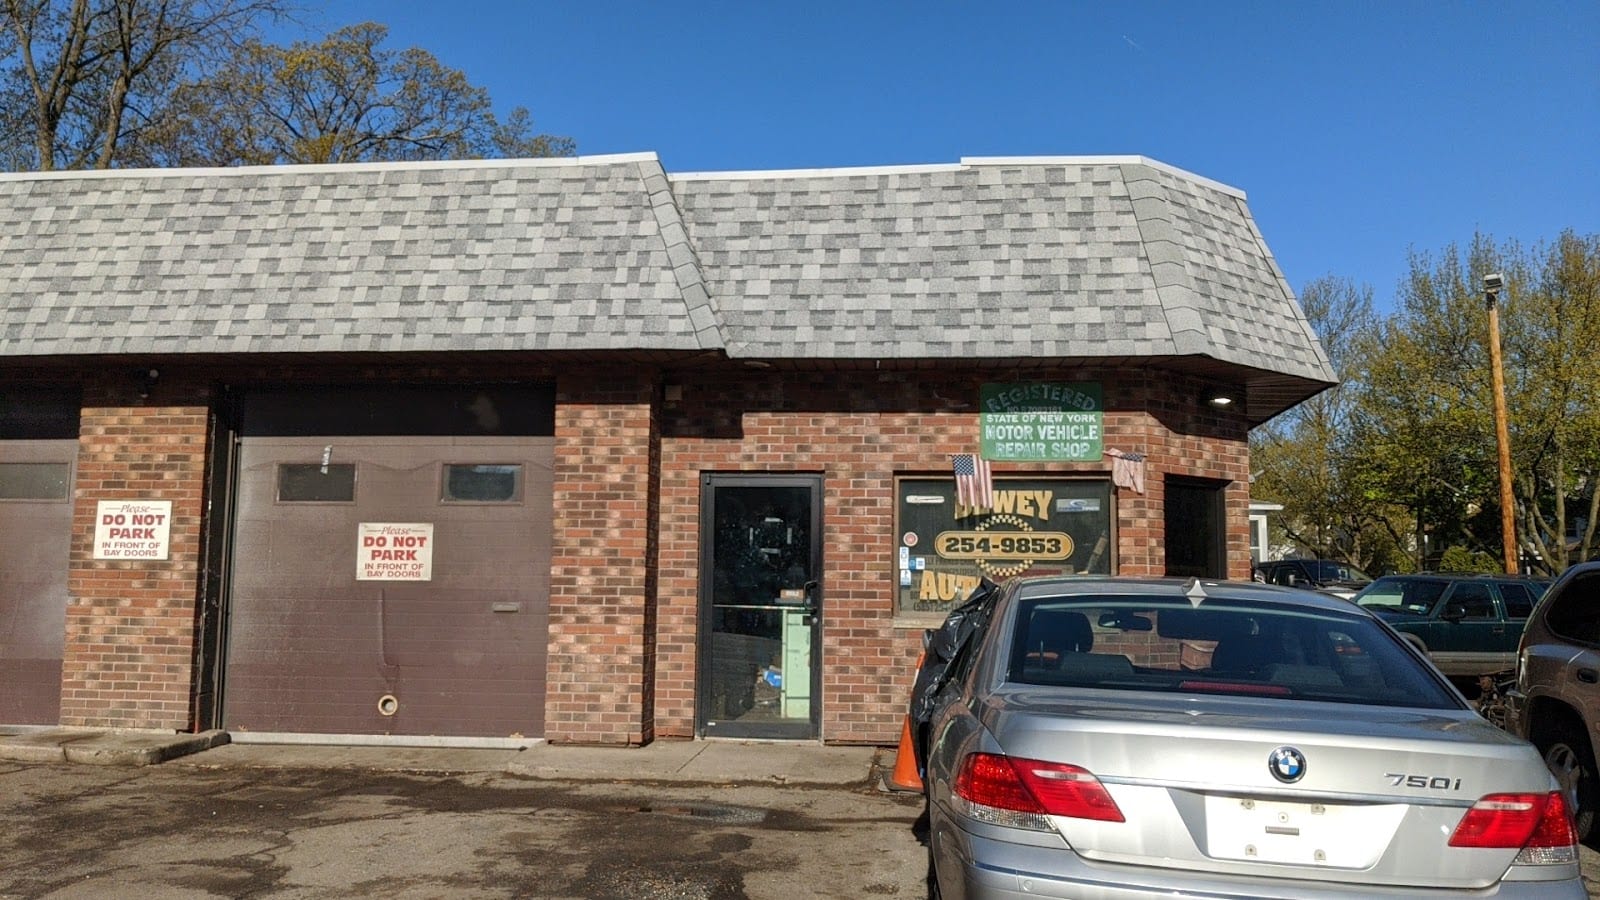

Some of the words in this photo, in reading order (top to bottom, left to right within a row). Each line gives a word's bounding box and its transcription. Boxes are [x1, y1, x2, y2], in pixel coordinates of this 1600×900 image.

[986, 384, 1096, 412] REGISTERED
[986, 414, 1019, 423] STATE
[1022, 414, 1037, 423] OF
[1040, 414, 1064, 423] NEW
[1066, 414, 1097, 423] YORK
[985, 425, 1034, 441] MOTOR
[1037, 425, 1099, 441] VEHICLE
[995, 442, 1046, 458] REPAIR
[1051, 442, 1091, 458] SHOP
[120, 503, 151, 514] Please
[102, 514, 126, 526] DO
[132, 514, 166, 526] NOT
[109, 527, 155, 539] PARK
[381, 526, 412, 535] Please
[148, 541, 161, 549] OF
[363, 536, 387, 548] DO
[393, 536, 427, 548] NOT
[945, 537, 1062, 554] 254-9853
[104, 549, 121, 557] BAY
[124, 549, 158, 557] DOORS
[371, 549, 418, 561] PARK
[919, 570, 981, 601] AUT
[1383, 772, 1462, 791] 750i
